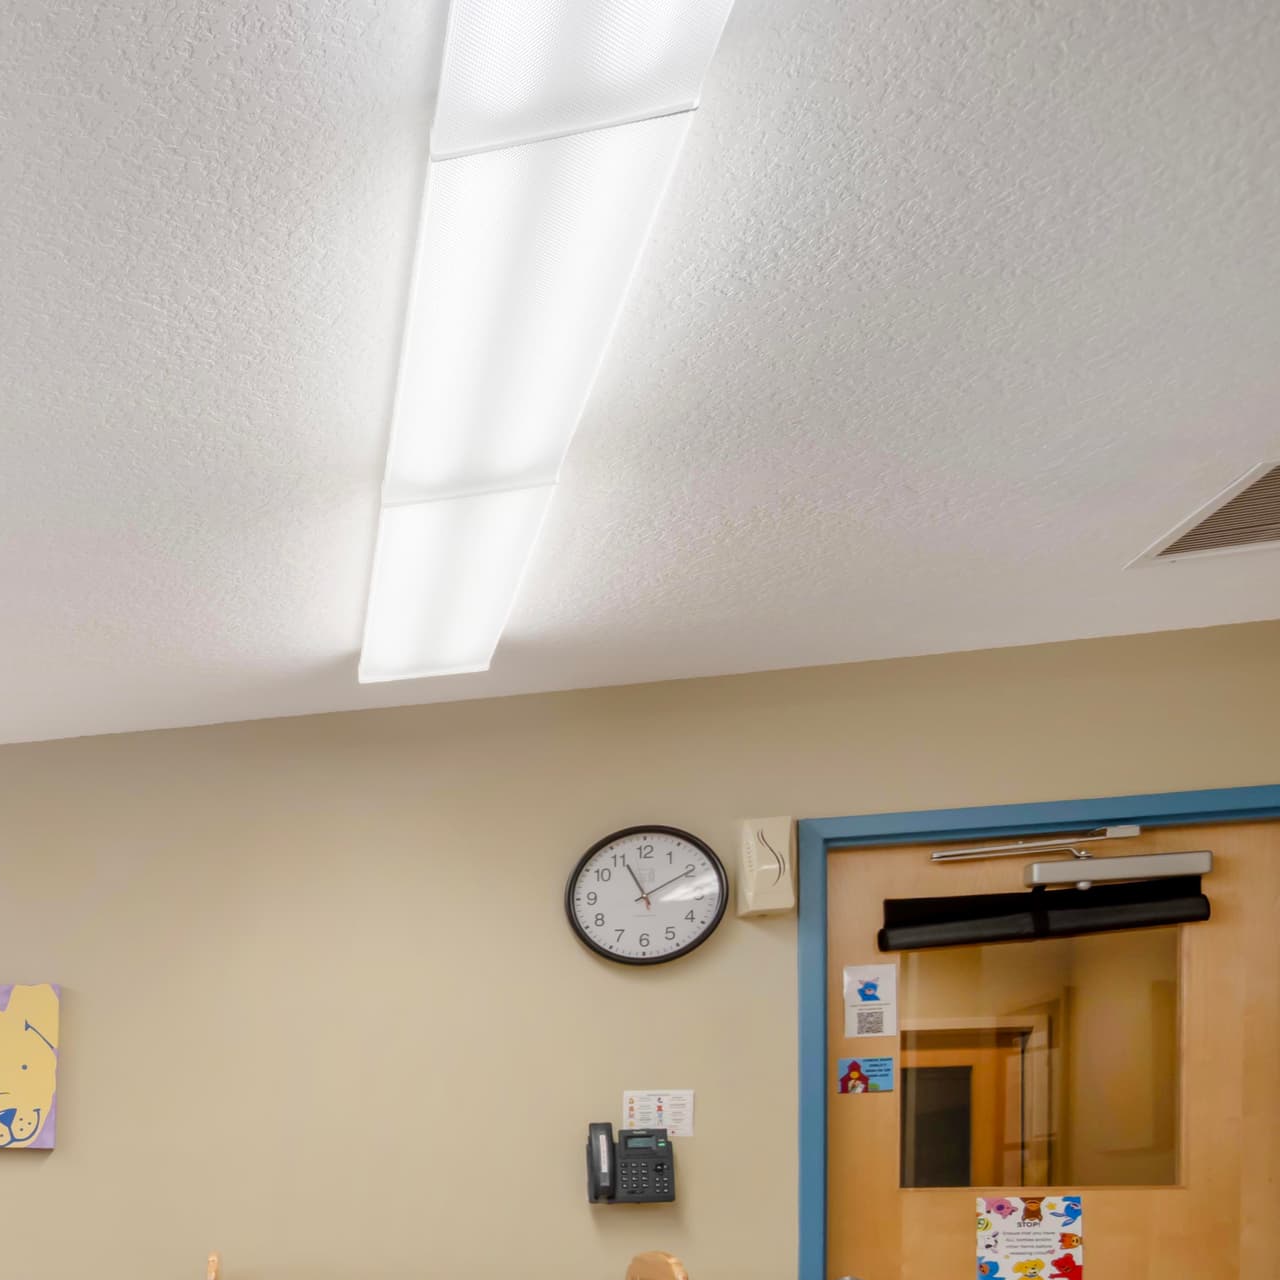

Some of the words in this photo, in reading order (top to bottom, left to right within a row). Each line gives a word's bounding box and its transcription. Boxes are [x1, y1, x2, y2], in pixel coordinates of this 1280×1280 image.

[637, 844, 654, 859] 12
[666, 851, 673, 865] 1
[611, 853, 627, 868] 11
[594, 868, 611, 882] 10
[684, 863, 696, 878] 2
[586, 891, 597, 906] 9
[594, 912, 605, 927] 8
[684, 909, 696, 923] 4
[614, 929, 625, 943] 7
[639, 933, 650, 948] 6
[665, 926, 676, 941] 5
